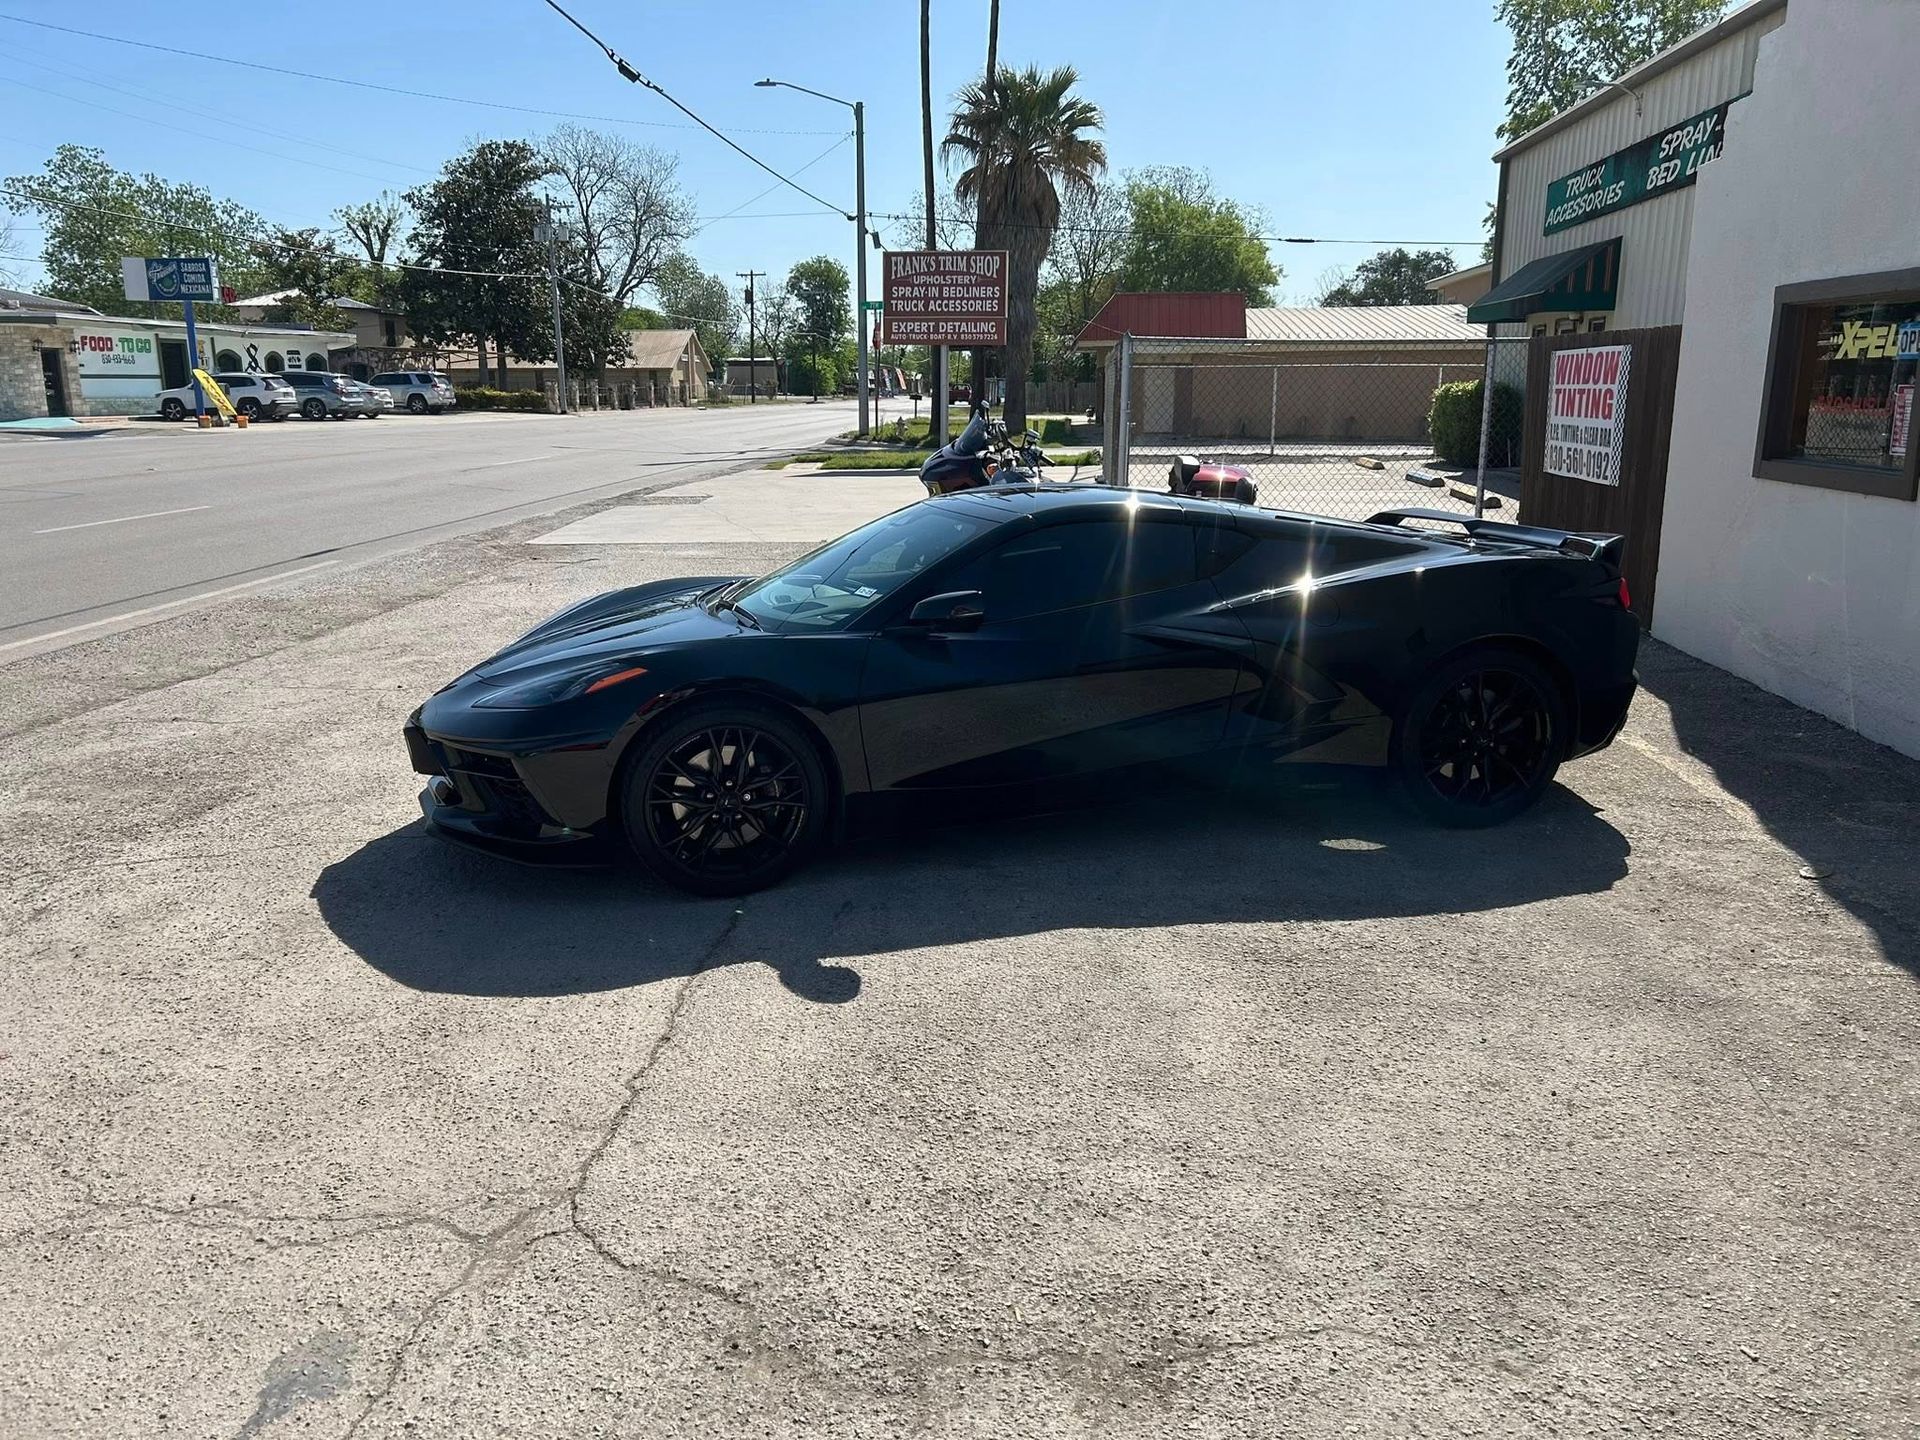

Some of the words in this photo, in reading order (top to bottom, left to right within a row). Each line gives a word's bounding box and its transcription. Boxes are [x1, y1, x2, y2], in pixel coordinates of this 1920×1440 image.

[1659, 113, 1722, 159] SPRAY-
[1566, 164, 1606, 199] TRUCK
[1646, 158, 1681, 190] BED
[1545, 180, 1625, 228] ACCESSORIES
[180, 262, 207, 273] SABROSA
[183, 273, 206, 283] COMIDA
[891, 256, 936, 279] FRANK'S
[938, 255, 967, 272] TRIM
[970, 255, 1000, 278] SHOP
[913, 275, 978, 285] UPHOLSTERY
[942, 286, 1000, 298] BEDLINERS
[891, 300, 925, 312] TRUCK
[928, 300, 999, 312] ACCESSORIES
[892, 322, 935, 333] EXPERT
[939, 322, 996, 333] DETAILING
[80, 335, 113, 352] FOOD
[118, 337, 135, 353] TO
[136, 338, 152, 353] GO
[1835, 320, 1899, 360] XPEL
[1554, 351, 1622, 385] WINDOW
[1554, 388, 1614, 420] TINTING
